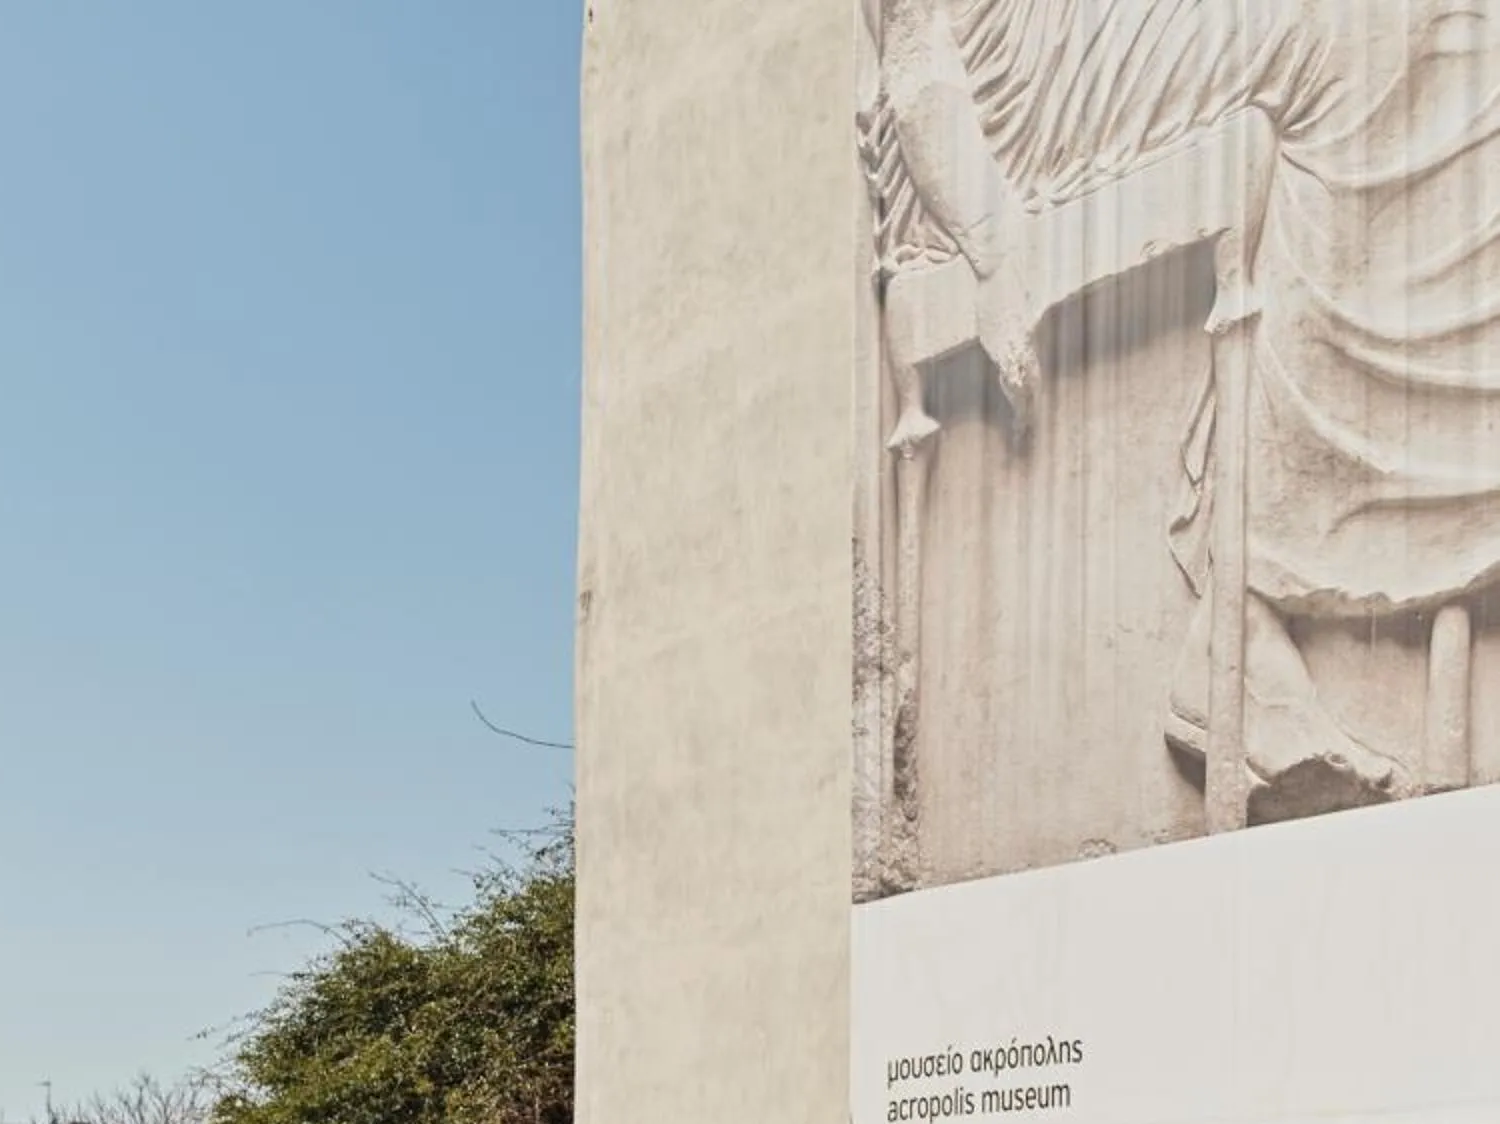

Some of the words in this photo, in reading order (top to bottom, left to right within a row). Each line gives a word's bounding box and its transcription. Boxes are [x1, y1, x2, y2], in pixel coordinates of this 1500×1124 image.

[887, 1045, 963, 1088] μουσείο
[970, 1034, 1083, 1077] ακρόπολης
[887, 1087, 975, 1124] acropolis
[981, 1082, 1071, 1113] museum
